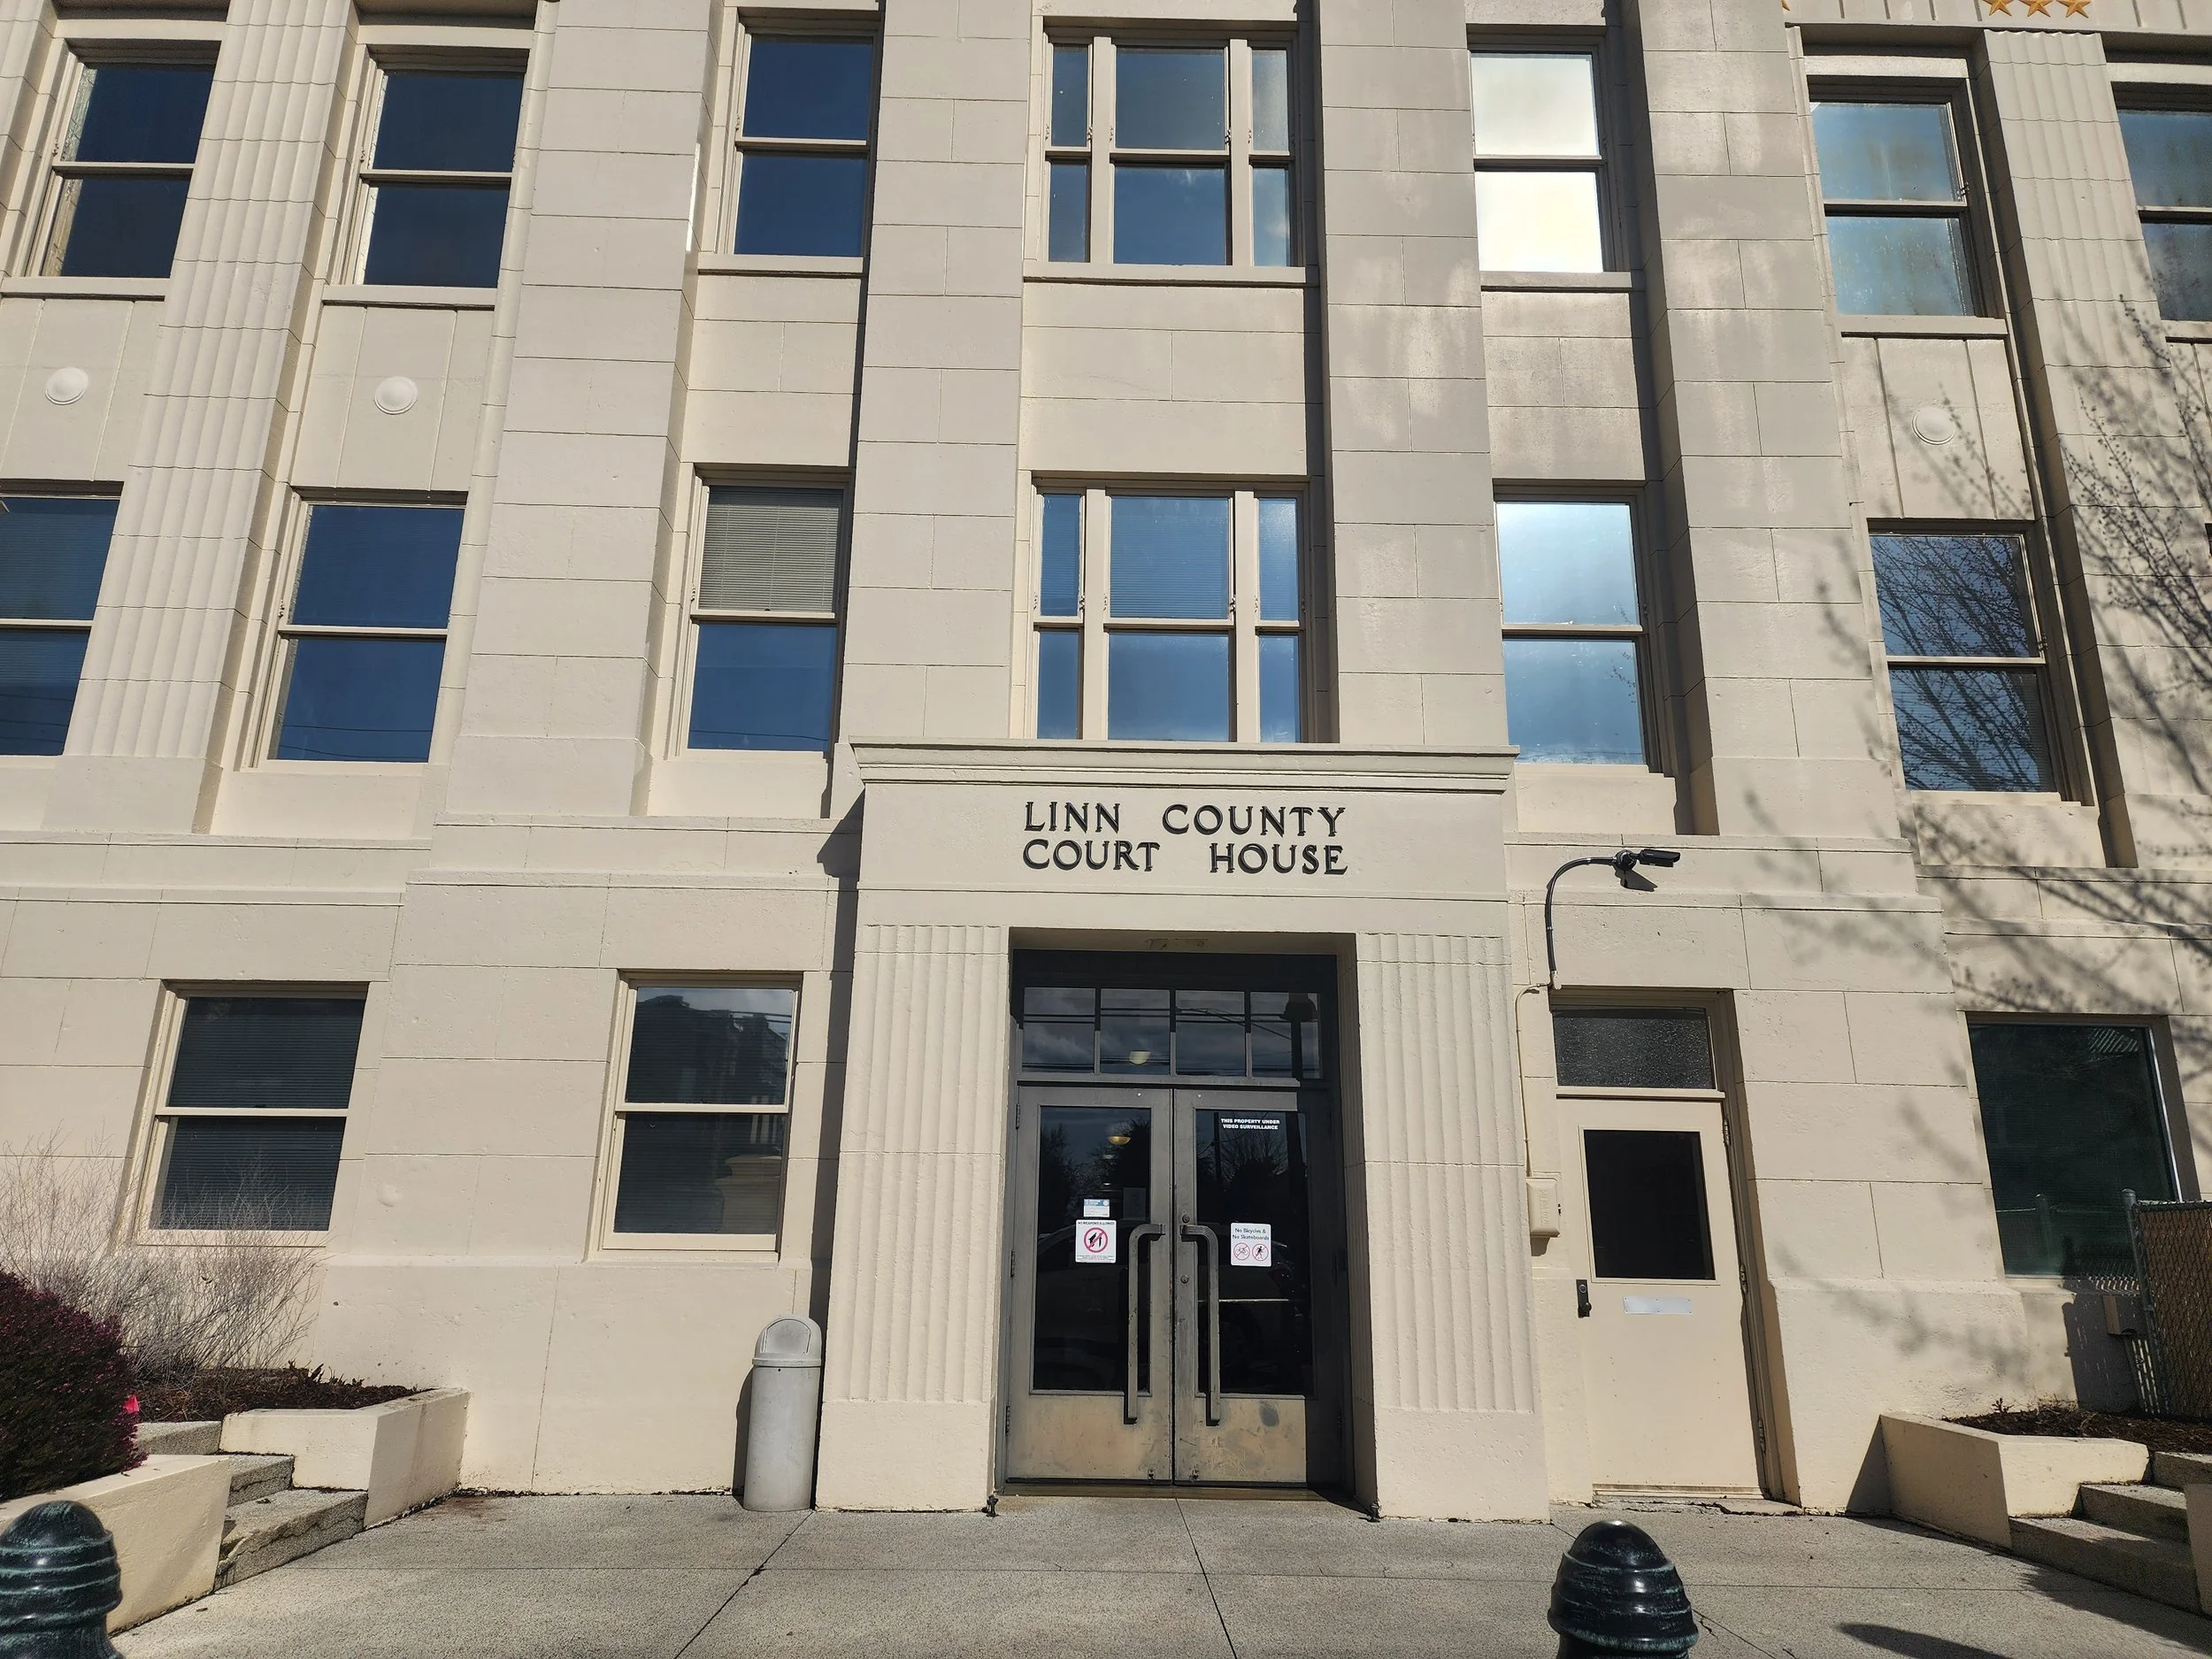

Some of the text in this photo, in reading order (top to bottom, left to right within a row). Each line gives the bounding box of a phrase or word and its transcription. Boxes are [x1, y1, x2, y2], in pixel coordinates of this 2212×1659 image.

[1024, 801, 1346, 837] LINN COUNTY
[1022, 839, 1348, 875] COURT HOUSE
